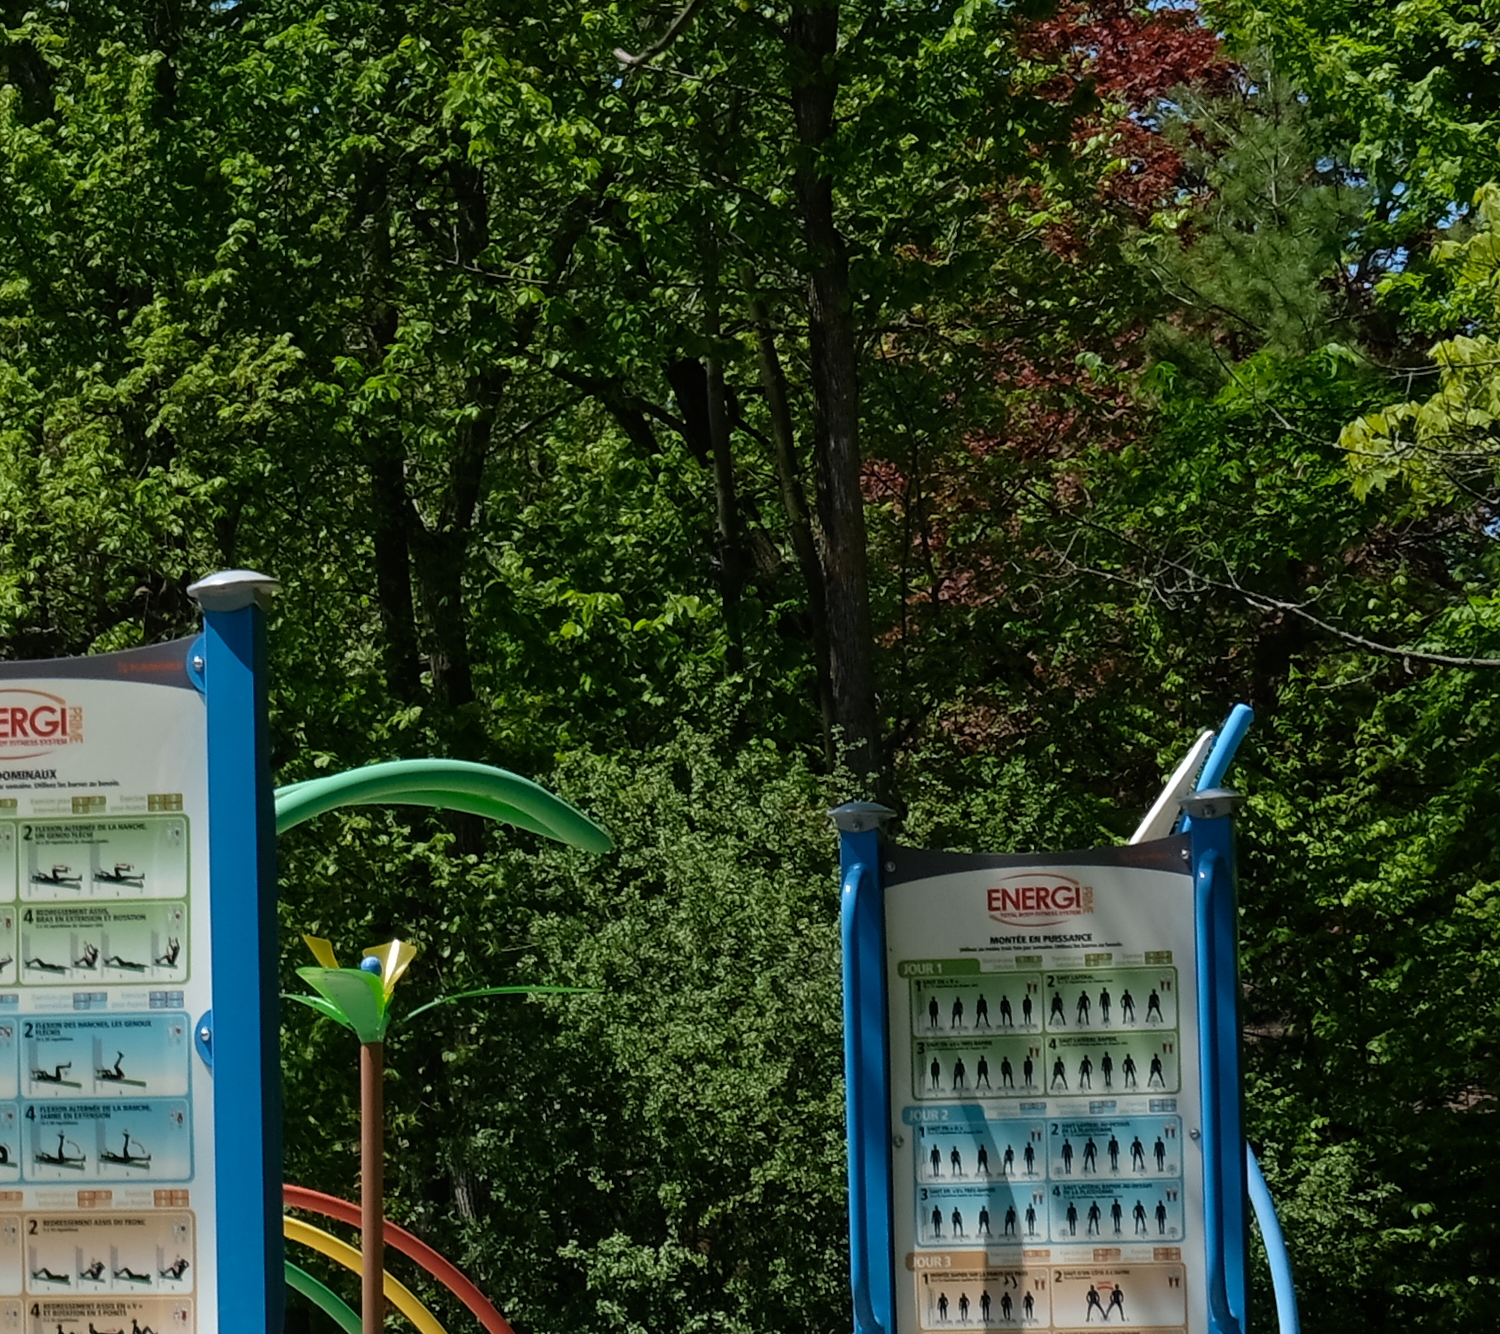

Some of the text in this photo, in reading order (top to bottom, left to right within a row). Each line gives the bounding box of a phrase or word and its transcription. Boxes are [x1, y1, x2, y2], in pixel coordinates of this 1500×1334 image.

[69, 707, 83, 744] PRIME
[23, 826, 33, 840] 2
[987, 887, 1082, 911] ENERGI
[24, 909, 33, 924] 4
[990, 934, 1027, 945] MONTÉE
[1043, 933, 1092, 942] PUISSANCE
[903, 964, 943, 975] JOUR 1
[916, 980, 922, 992] 1
[1047, 976, 1055, 987] 2
[24, 1023, 33, 1038] 2
[917, 1043, 925, 1054] 3
[1049, 1039, 1056, 1050] 4
[26, 1106, 36, 1121] 4
[908, 1110, 948, 1121] JOUR 2
[919, 1127, 925, 1138] 1
[1051, 1123, 1059, 1135] 2
[921, 1189, 928, 1200] 3
[1052, 1186, 1061, 1197] 4
[29, 1220, 38, 1235] 2
[944, 1256, 951, 1267] 3
[922, 1273, 928, 1285] 1
[1055, 1271, 1062, 1283] 2
[30, 1303, 40, 1318] 4
